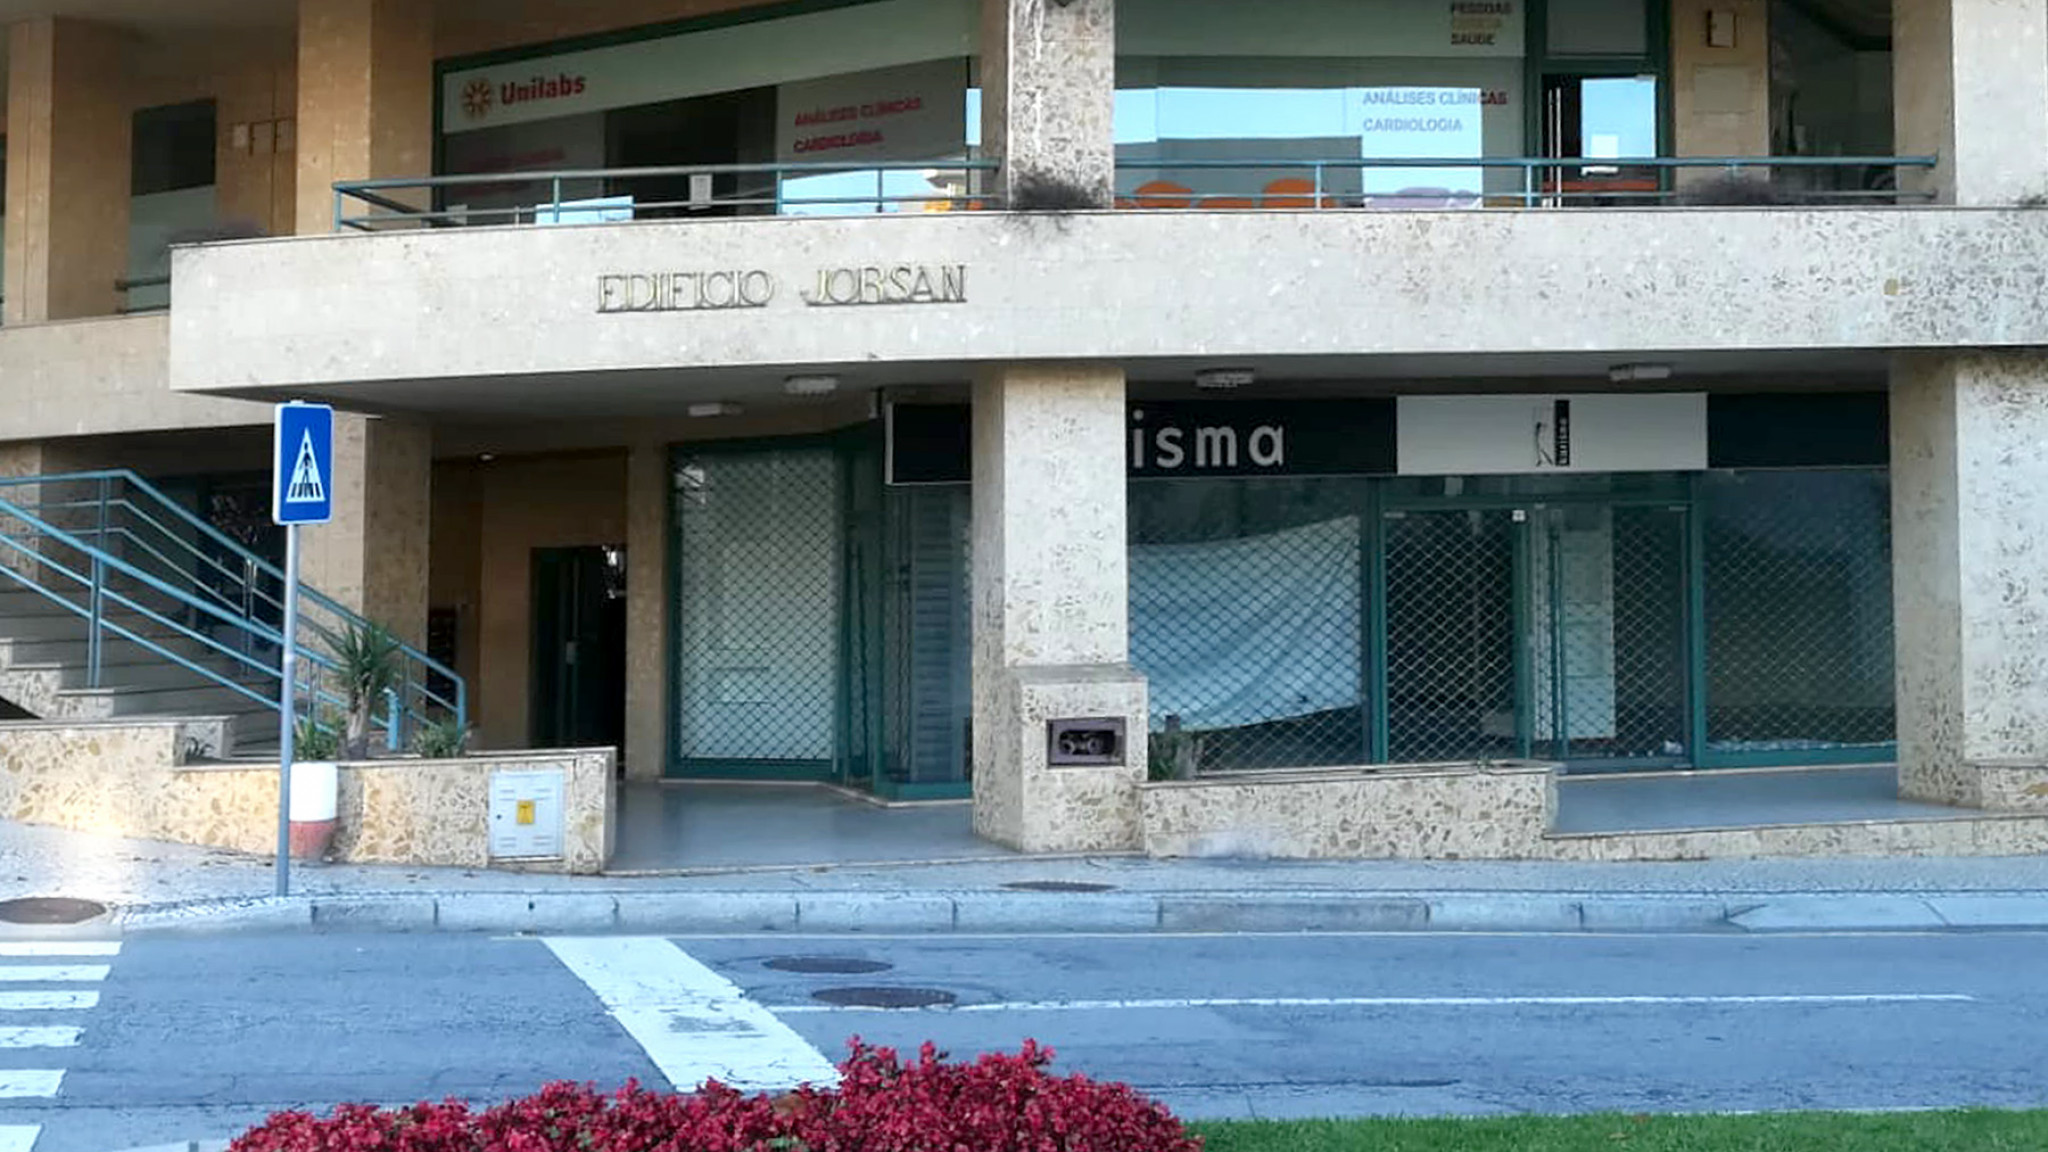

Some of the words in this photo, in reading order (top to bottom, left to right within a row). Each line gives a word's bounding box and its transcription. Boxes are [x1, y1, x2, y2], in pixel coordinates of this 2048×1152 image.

[501, 73, 586, 106] Unilabs
[1363, 118, 1463, 132] CARDIOLOGIA
[597, 270, 773, 313] EDIFICIO
[800, 265, 967, 307] JORSAN
